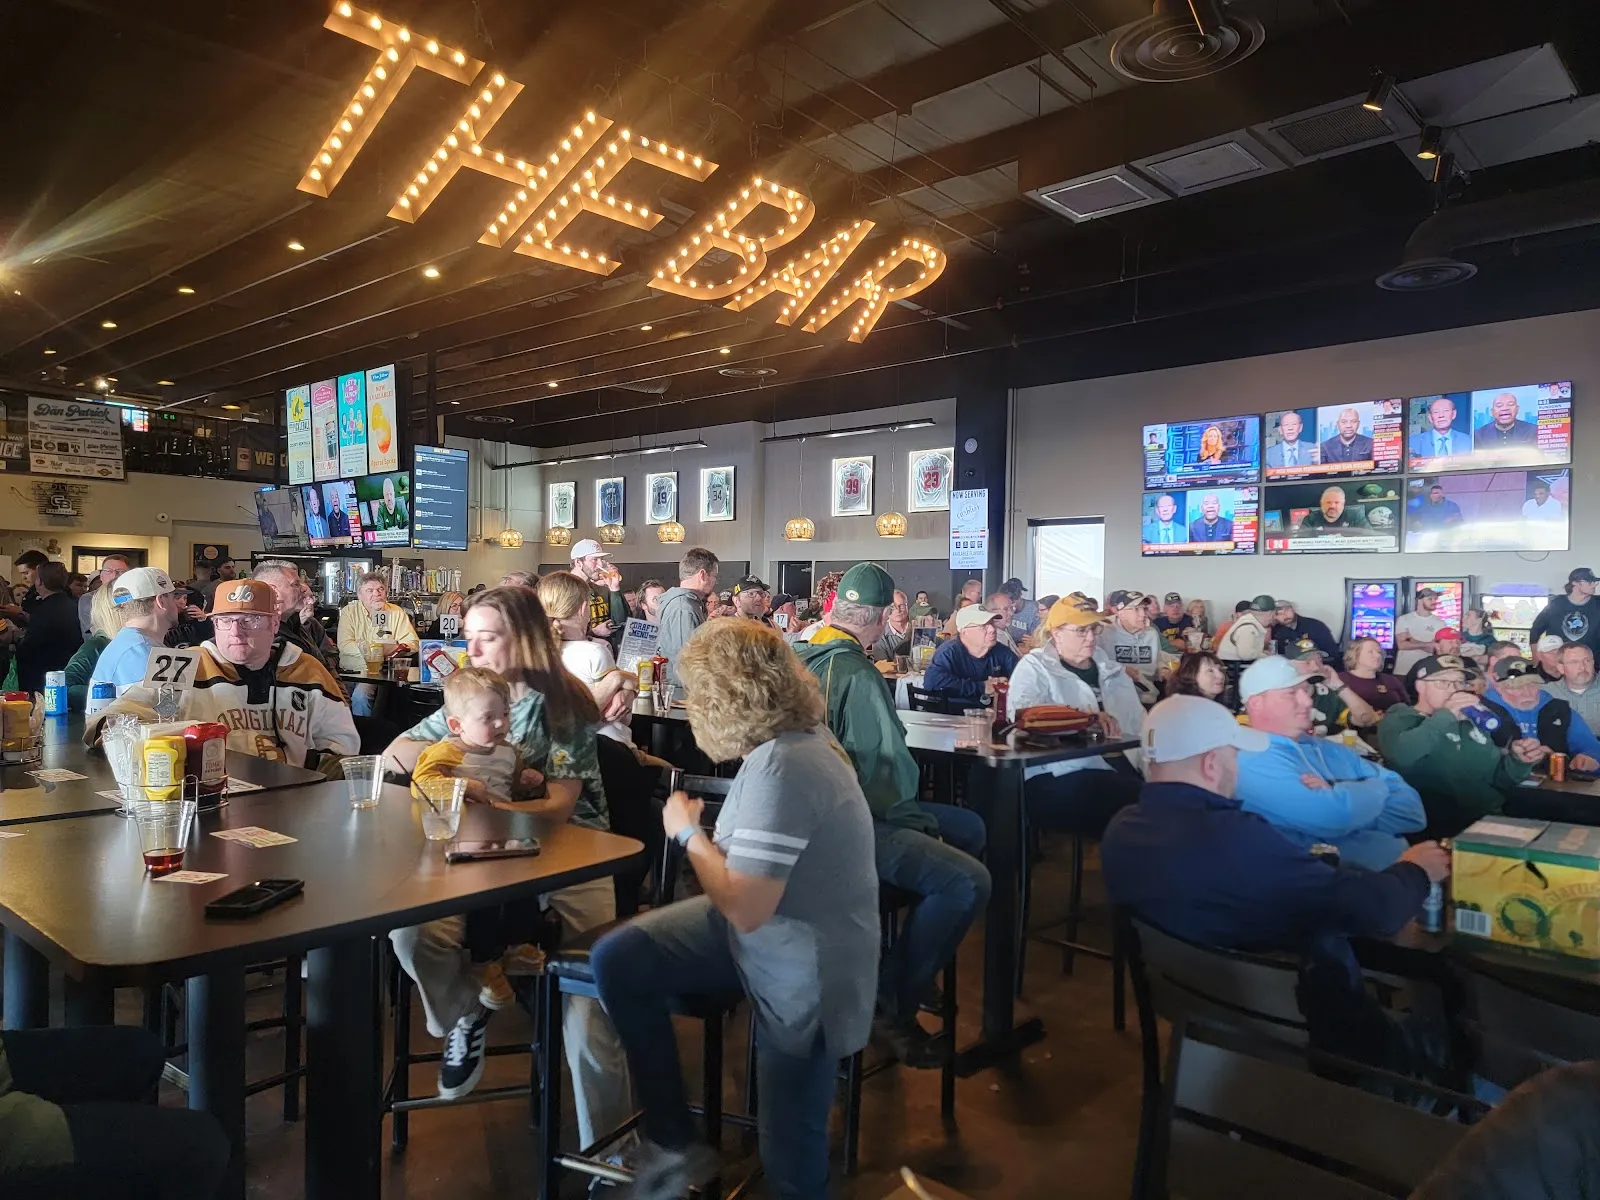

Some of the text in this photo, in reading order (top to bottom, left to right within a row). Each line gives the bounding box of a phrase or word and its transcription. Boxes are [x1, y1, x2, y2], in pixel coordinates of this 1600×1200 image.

[296, 0, 948, 343] THE BAR
[33, 403, 114, 423] Dan Patrick
[846, 478, 859, 495] 99
[923, 471, 940, 490] 23
[657, 491, 667, 504] 19
[713, 490, 722, 501] 34
[952, 490, 986, 499] NOW SERVING
[374, 613, 386, 625] 19
[442, 617, 455, 631] 20
[776, 615, 785, 624] 17
[633, 621, 655, 632] DRAFT
[632, 630, 649, 639] MENU
[151, 655, 193, 682] 27
[217, 708, 305, 738] ORIGINAL
